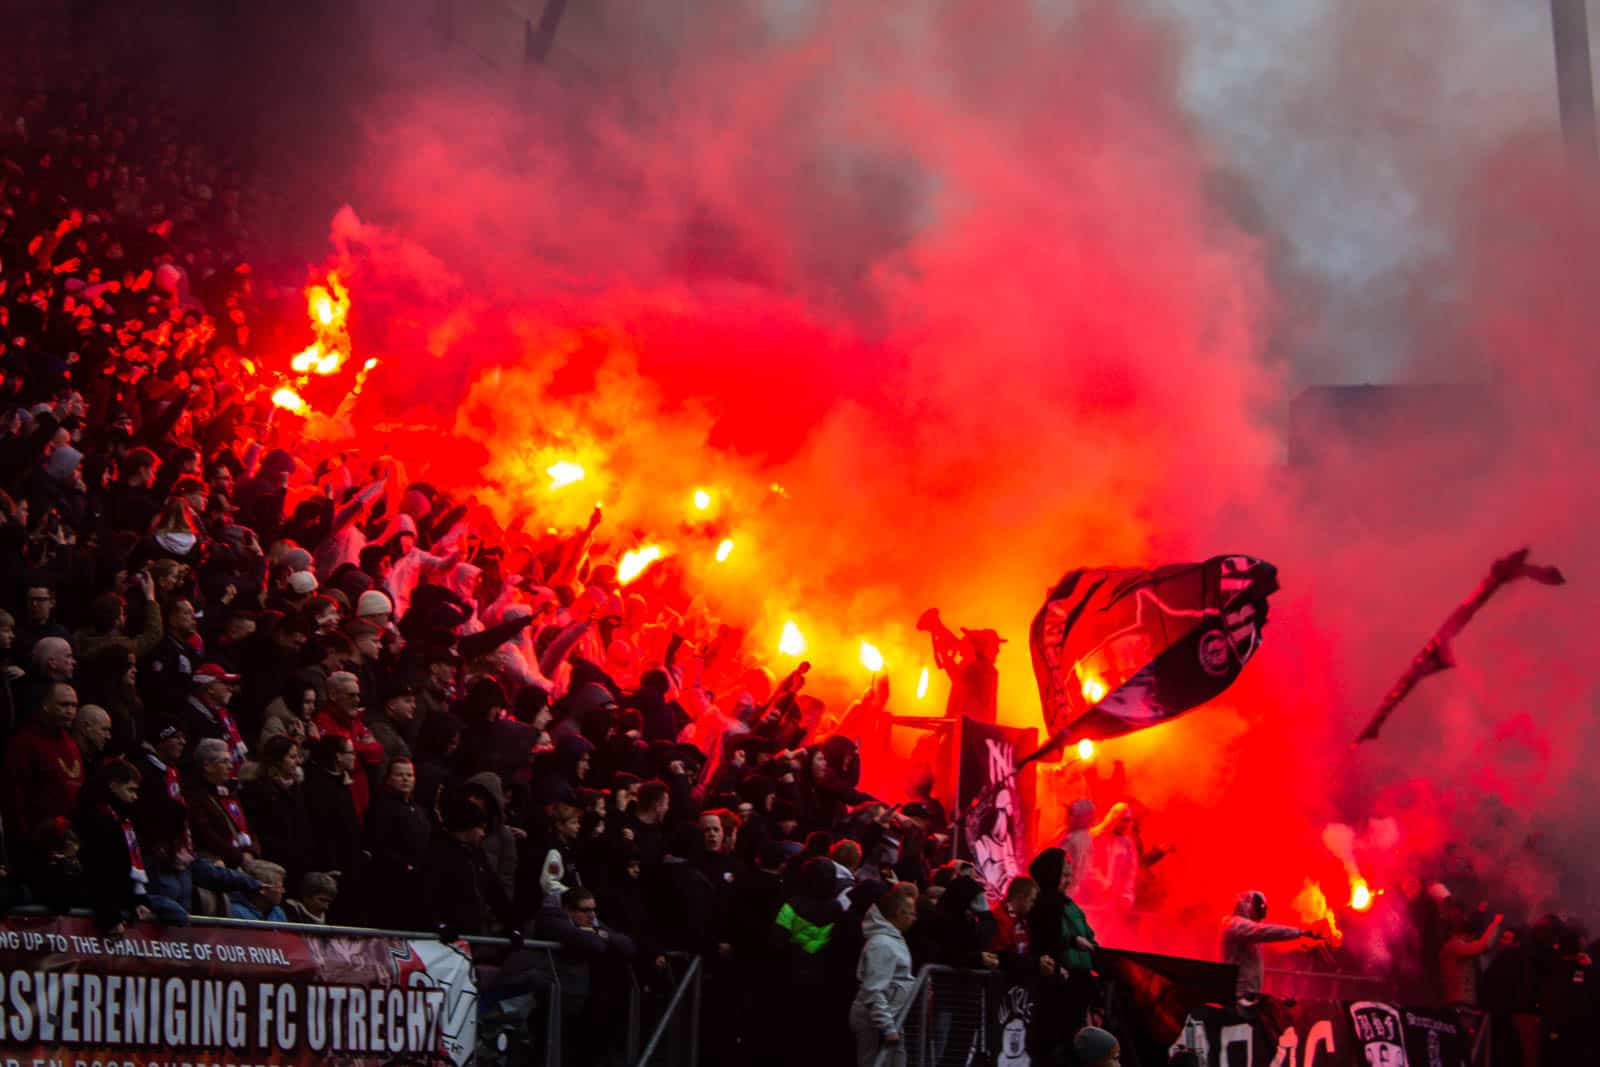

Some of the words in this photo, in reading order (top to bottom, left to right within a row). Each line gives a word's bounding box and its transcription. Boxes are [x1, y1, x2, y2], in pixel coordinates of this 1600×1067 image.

[23, 932, 43, 951] UP
[47, 934, 68, 953] TO
[70, 936, 101, 954] THE
[103, 938, 192, 960] CHALLENGE
[193, 944, 212, 961] OF
[216, 945, 246, 963] OUR
[249, 947, 290, 966] RIVAL
[0, 970, 247, 1048] SVERENIGING
[258, 983, 297, 1051] FC
[307, 985, 443, 1052] UTRECHT
